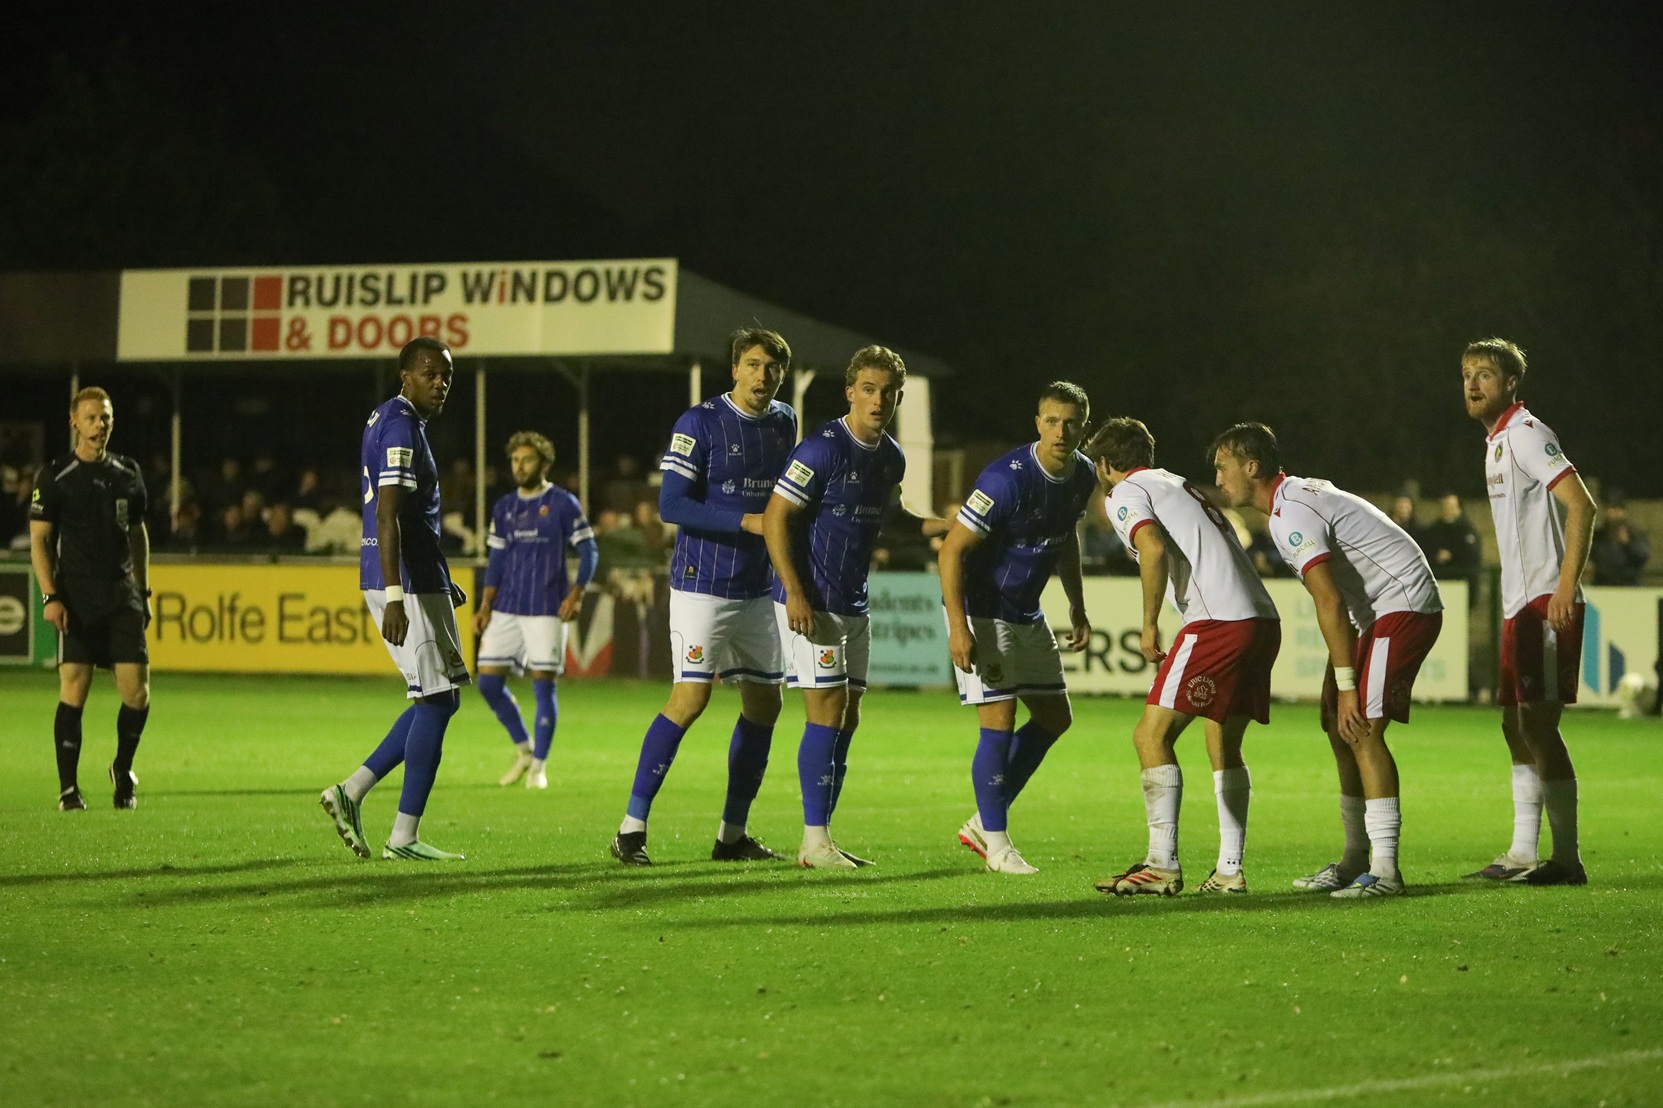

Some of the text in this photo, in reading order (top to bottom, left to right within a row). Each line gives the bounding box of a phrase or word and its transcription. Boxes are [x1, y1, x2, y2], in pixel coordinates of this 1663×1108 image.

[287, 271, 448, 308] RUISLIP
[285, 316, 311, 351] &
[156, 592, 371, 645] Rolfe East
